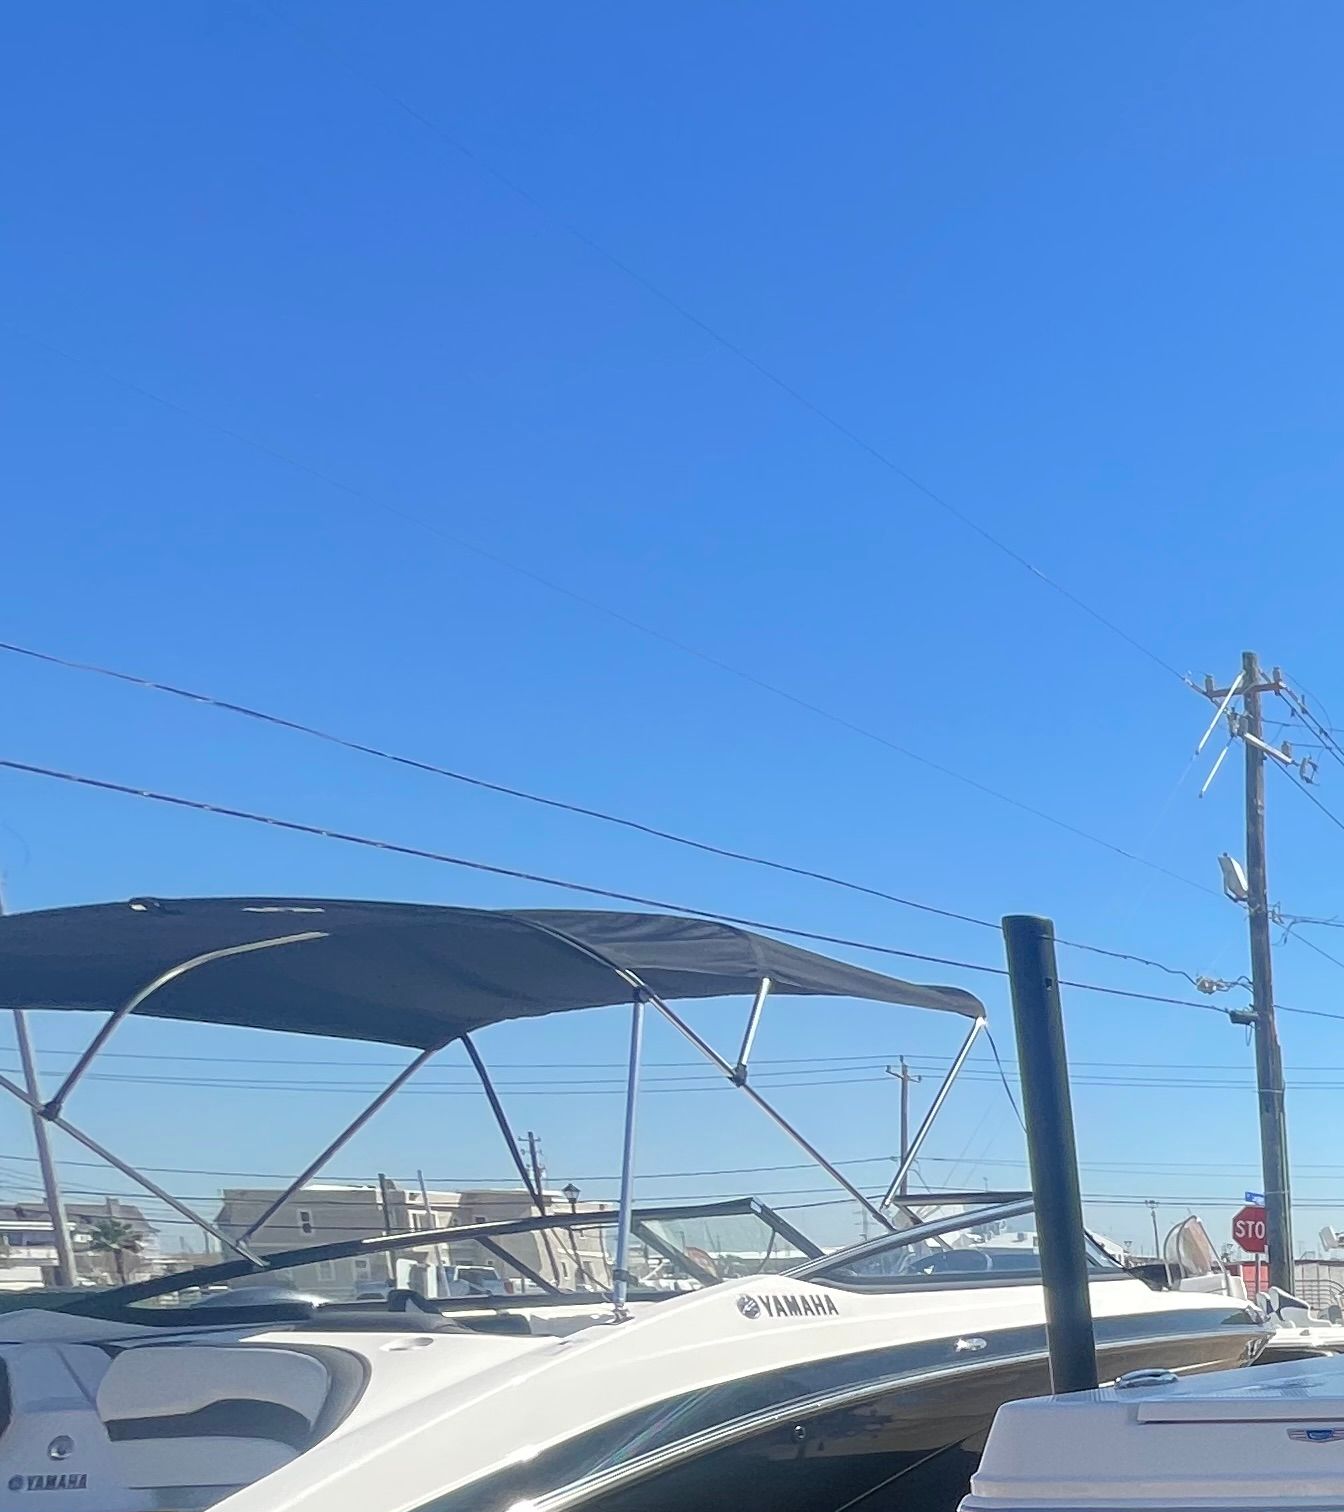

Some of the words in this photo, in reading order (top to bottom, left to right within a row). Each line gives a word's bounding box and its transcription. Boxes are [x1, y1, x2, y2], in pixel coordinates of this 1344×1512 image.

[1235, 1220, 1265, 1239] STO
[758, 1294, 839, 1317] YAMAHA
[27, 1474, 87, 1490] YAMAHA
